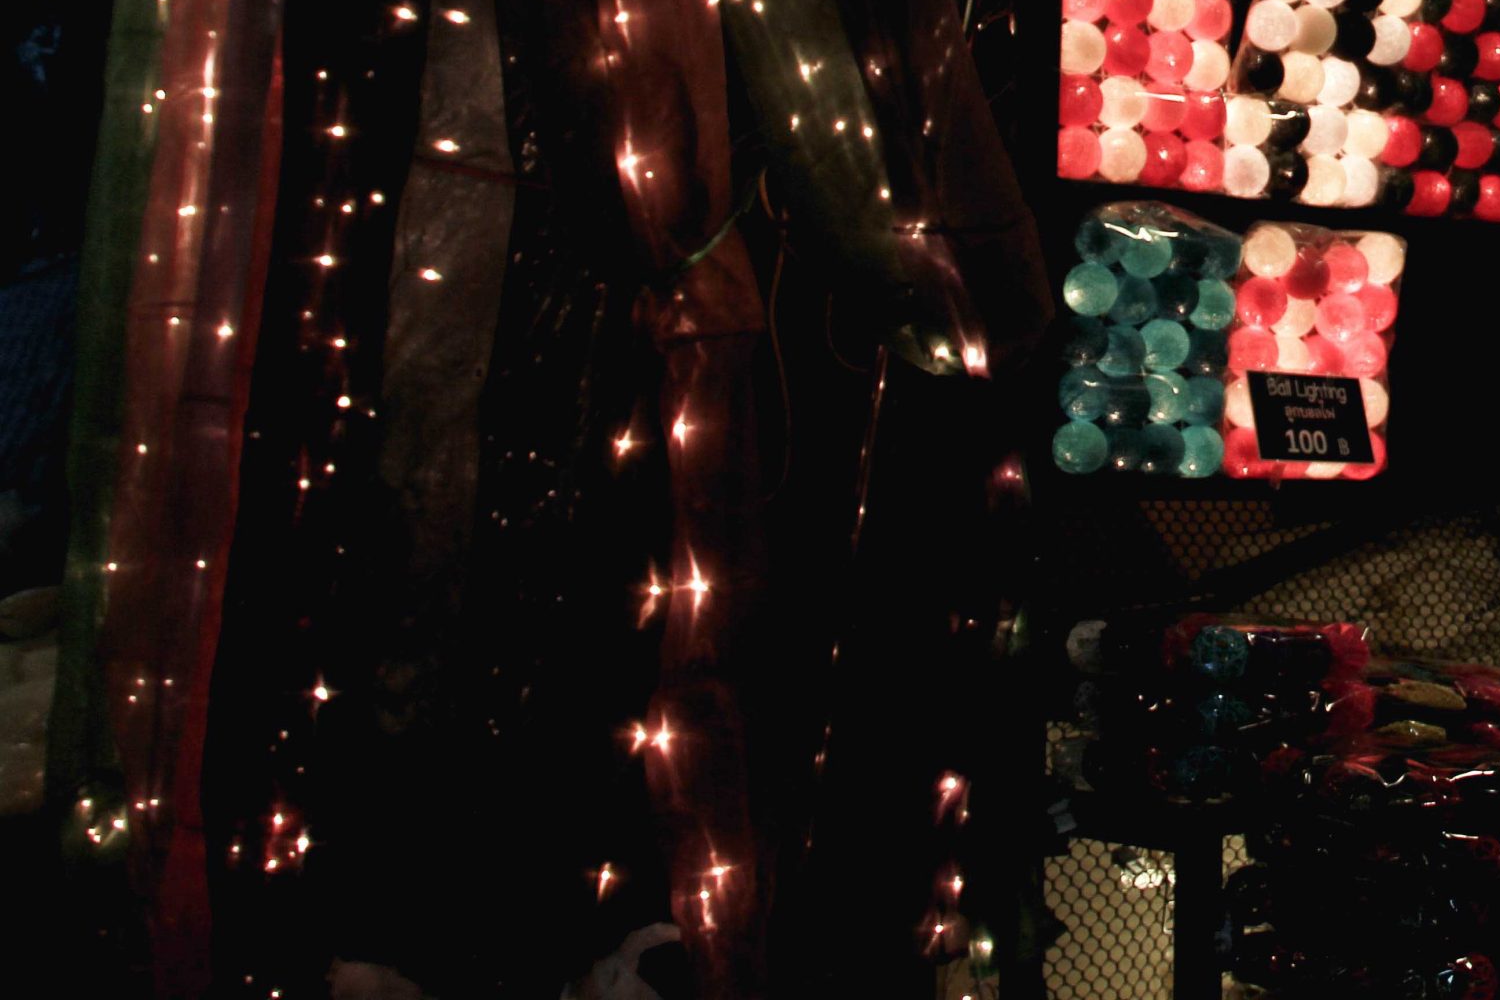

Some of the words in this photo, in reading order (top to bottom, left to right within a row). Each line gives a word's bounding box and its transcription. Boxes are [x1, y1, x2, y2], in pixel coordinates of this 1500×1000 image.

[1267, 376, 1292, 396] Ball
[1294, 378, 1347, 404] Lighting
[1285, 429, 1328, 454] 100
